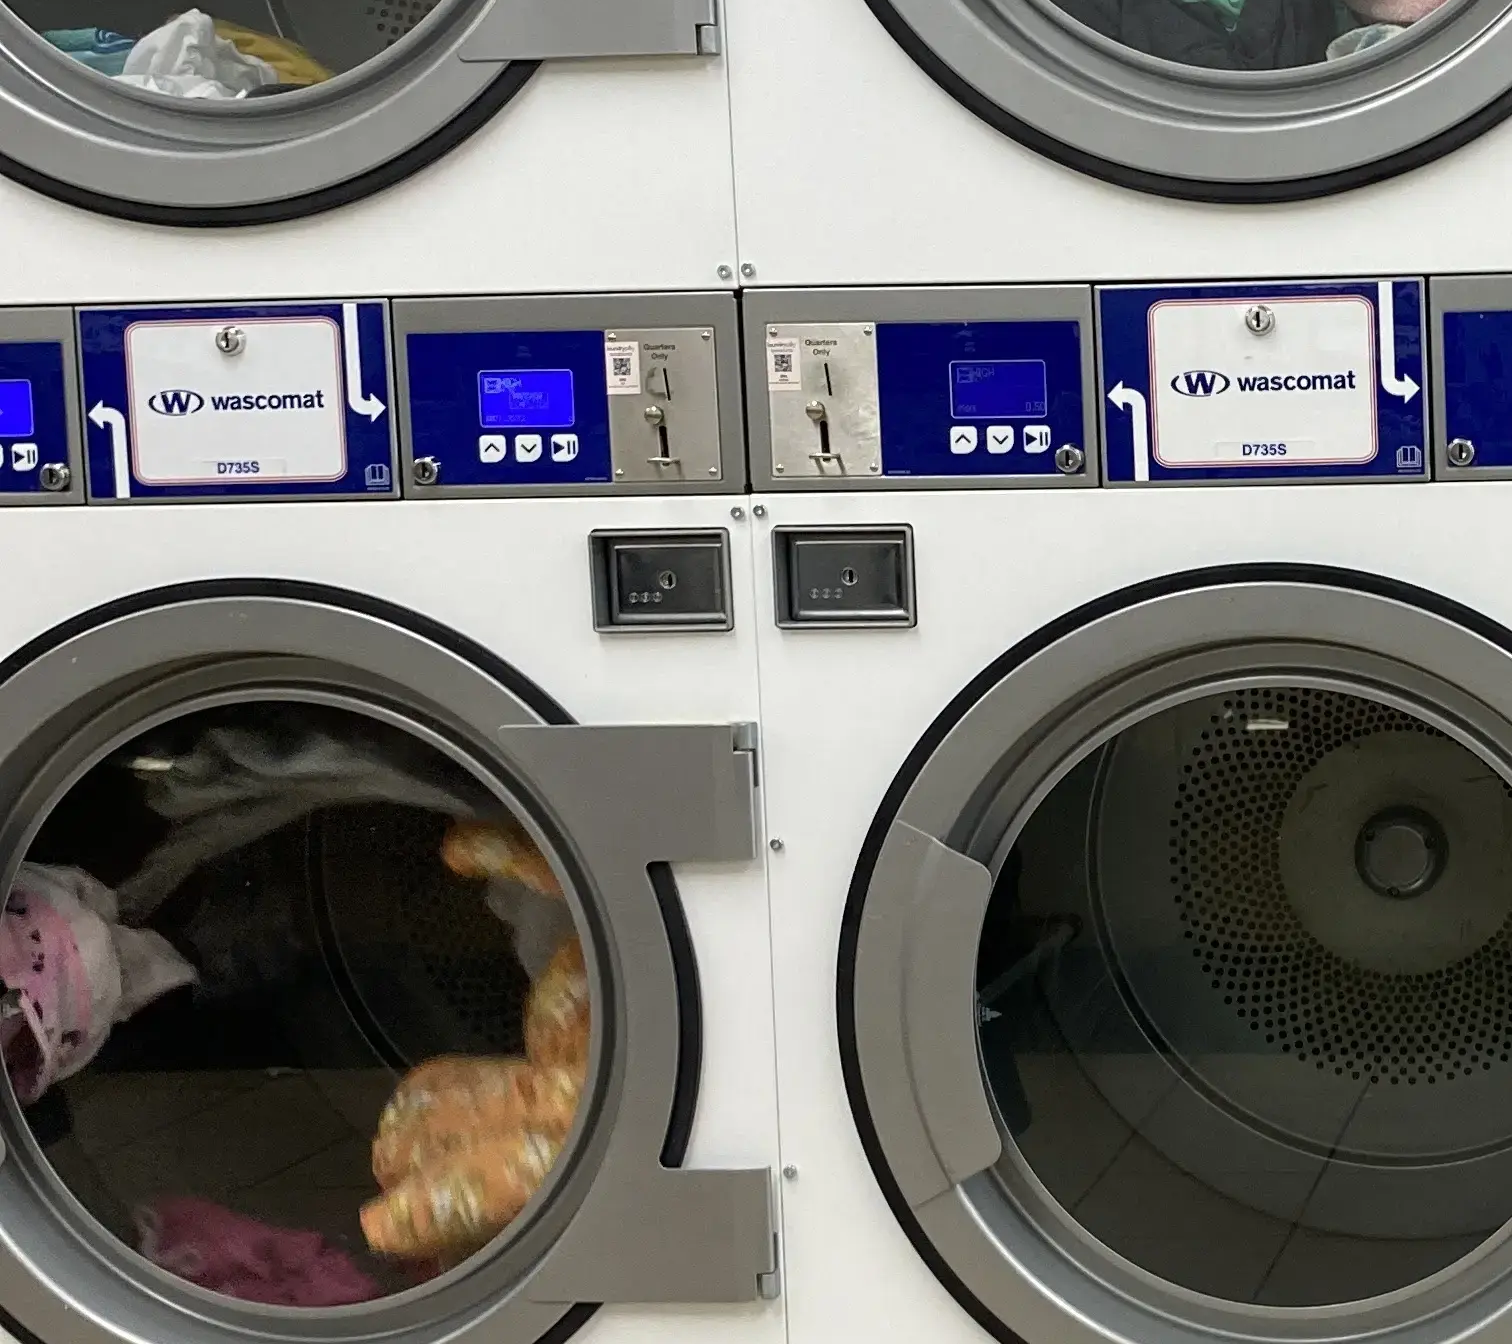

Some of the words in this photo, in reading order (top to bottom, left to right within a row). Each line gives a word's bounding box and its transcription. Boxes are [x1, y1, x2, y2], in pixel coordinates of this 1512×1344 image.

[643, 343, 676, 351] Quarters
[812, 348, 831, 356] Only
[1237, 371, 1356, 392] wascomat
[211, 390, 325, 411] wascomat
[1242, 444, 1287, 456] D735S
[217, 461, 260, 474] D735S
